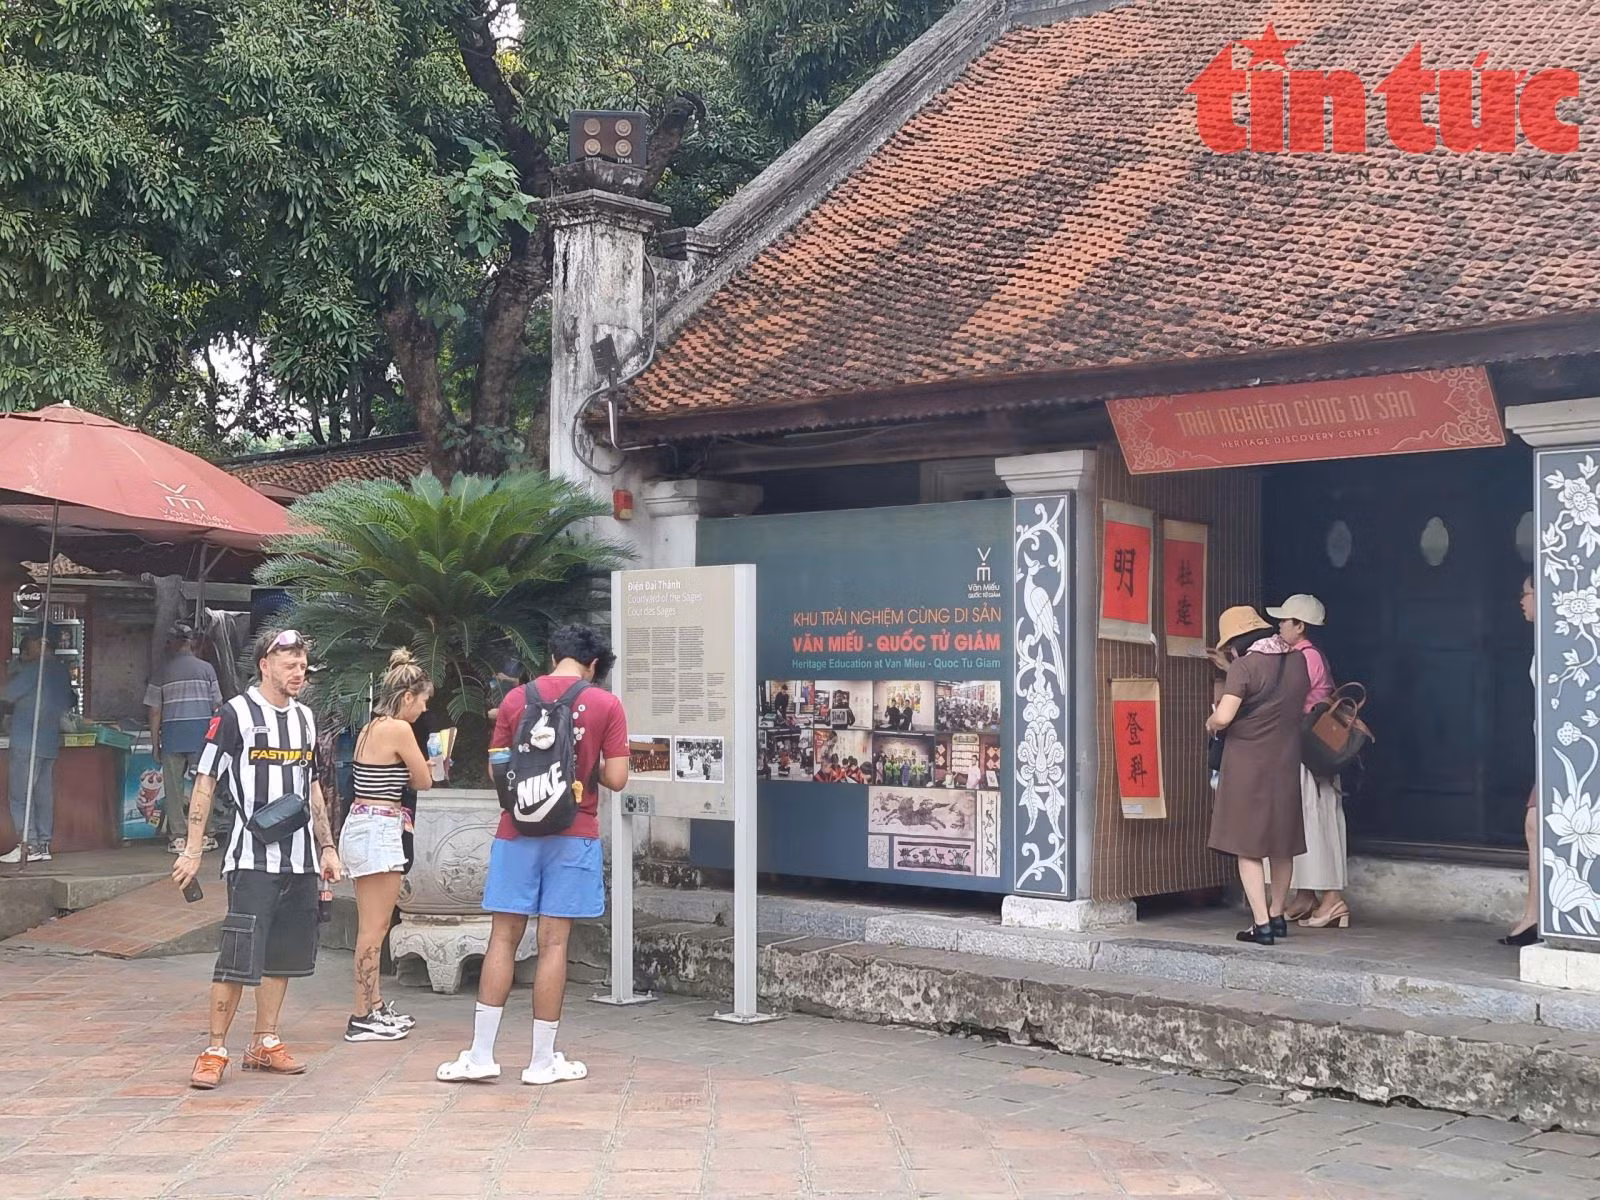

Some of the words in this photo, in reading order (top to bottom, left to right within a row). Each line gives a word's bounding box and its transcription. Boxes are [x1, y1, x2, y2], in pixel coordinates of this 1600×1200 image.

[1350, 394, 1371, 421] DI
[1221, 436, 1271, 449] HERITAGE
[1274, 432, 1335, 446] DISCOVERY
[1338, 427, 1381, 440] CENTER
[1113, 547, 1136, 598] 明
[661, 592, 669, 603] of
[669, 592, 681, 603] the
[682, 592, 703, 604] Sages
[627, 607, 643, 617] Cour
[644, 606, 655, 616] des
[656, 605, 676, 617] Sages
[793, 611, 818, 627] KHU
[820, 606, 847, 626] TRẢI
[850, 607, 904, 628] NGHIỆM
[907, 605, 951, 624] CÙNG
[954, 607, 969, 623] DI
[972, 602, 1002, 622] SẢN
[792, 632, 824, 653] VĂN
[828, 629, 864, 652] MIẾU
[876, 628, 926, 653] QUỐC
[930, 628, 951, 652] TỬ
[955, 629, 1001, 652] GIÁM
[792, 659, 827, 671] Heritage
[829, 659, 872, 669] Education
[874, 660, 883, 669] at
[884, 658, 902, 669] Van
[903, 658, 926, 669] Mieu
[933, 658, 959, 670] Quoc
[961, 658, 974, 669] Tu
[975, 657, 1001, 669] Giam
[517, 760, 562, 810] NIKE
